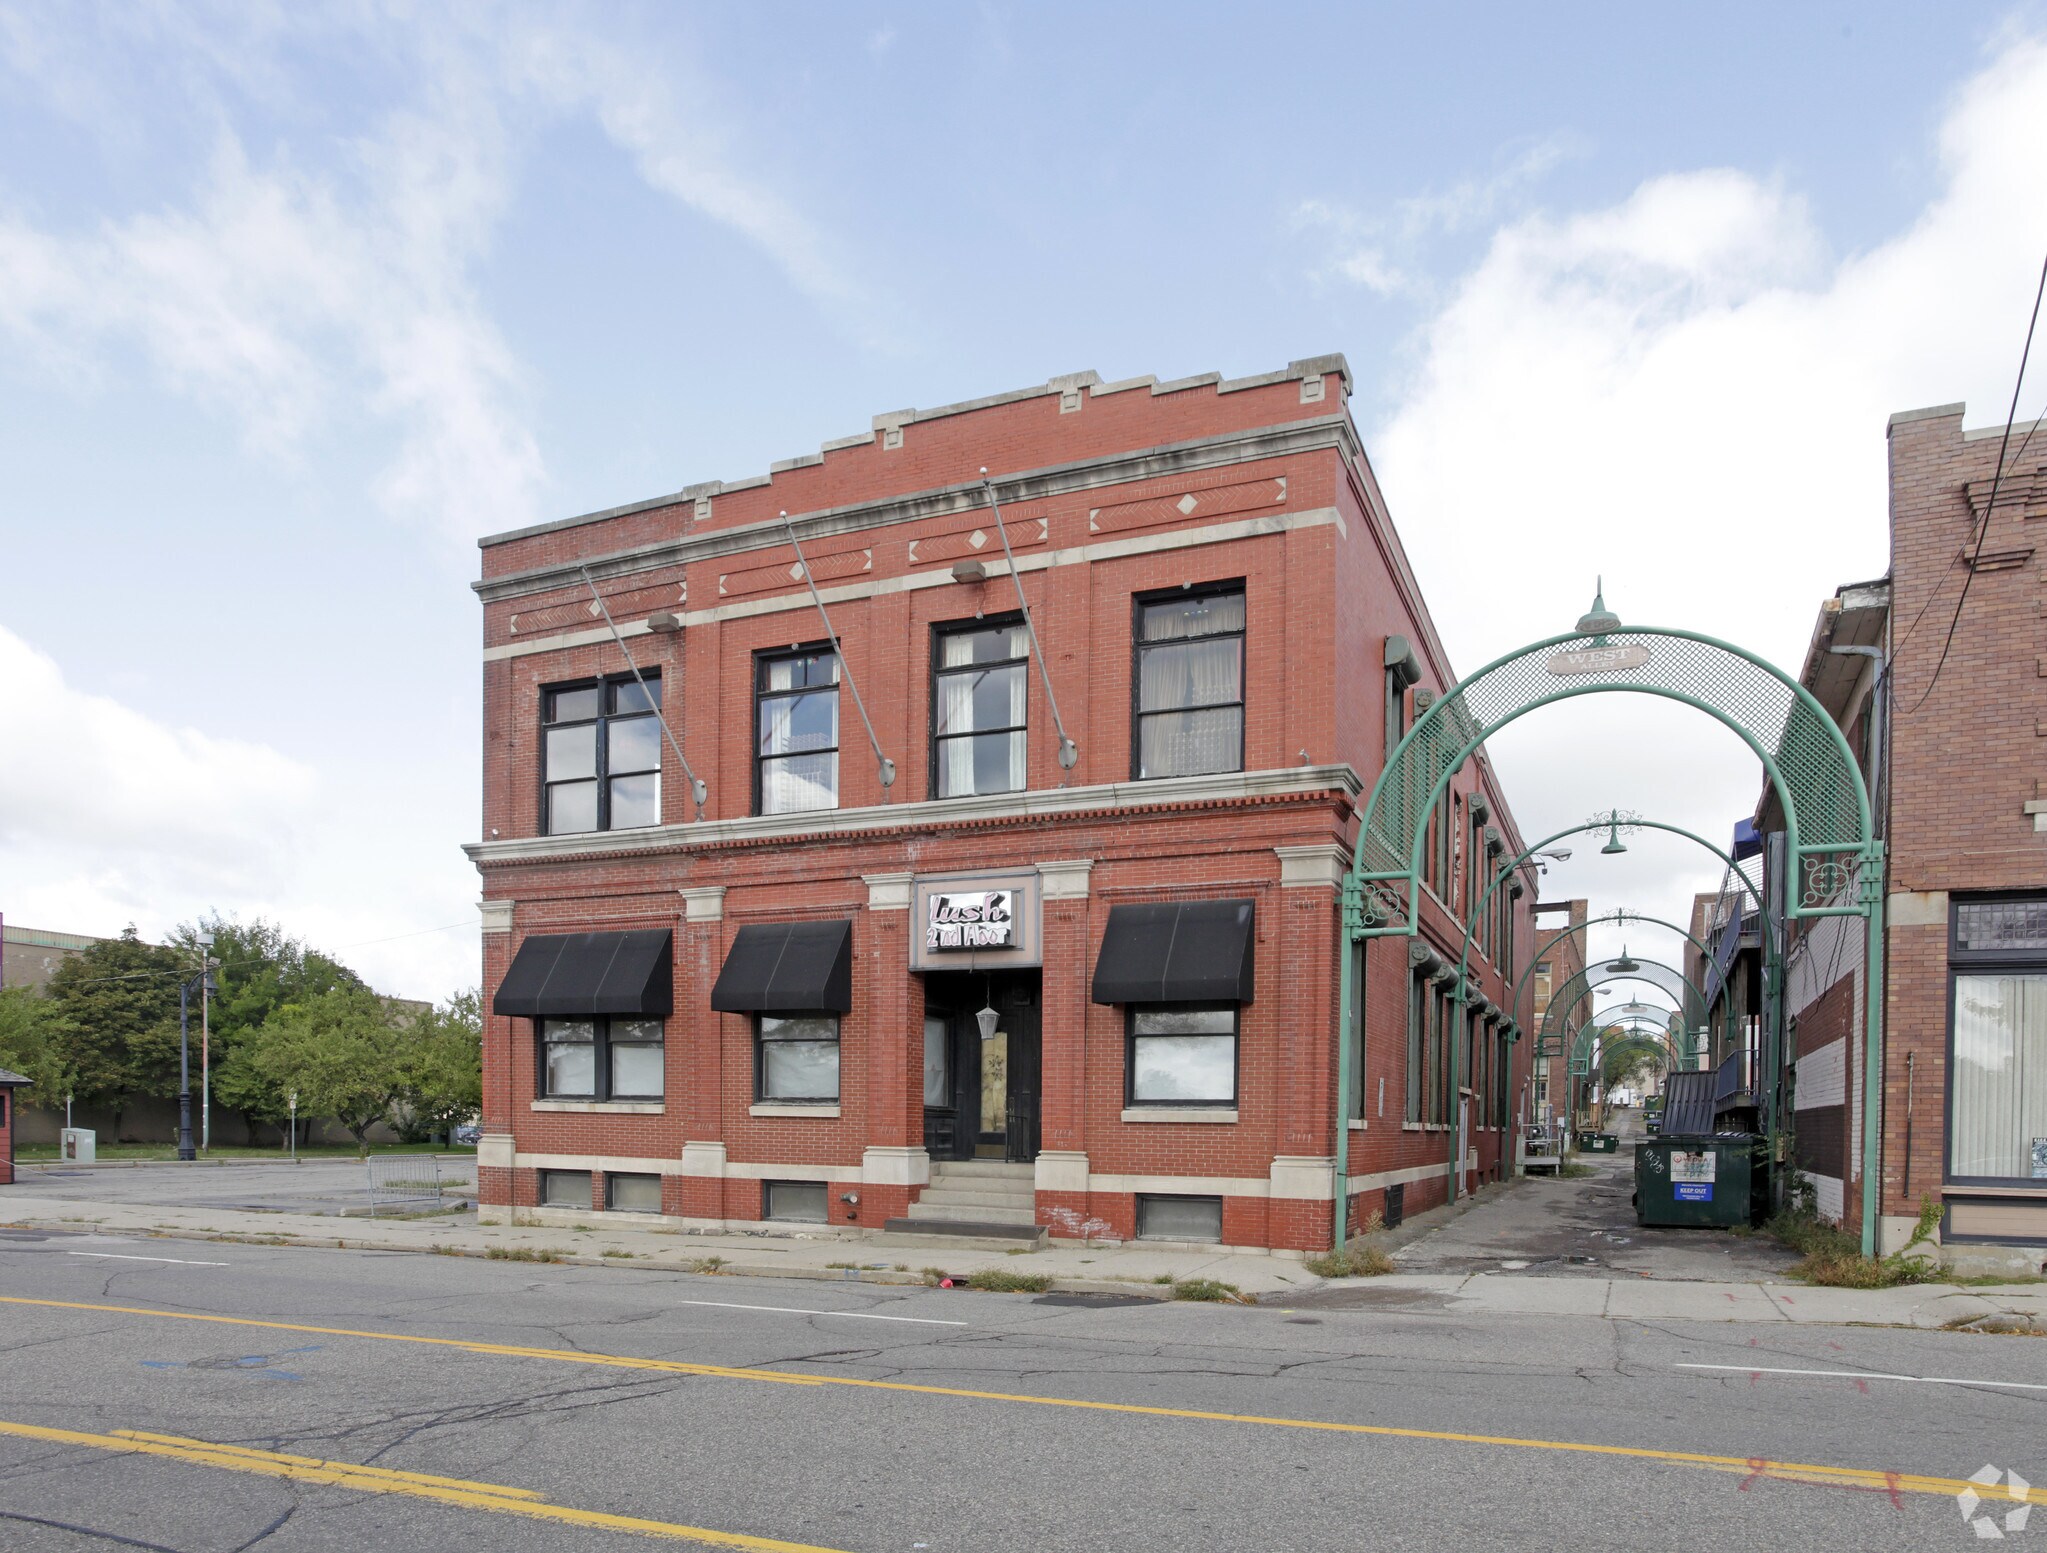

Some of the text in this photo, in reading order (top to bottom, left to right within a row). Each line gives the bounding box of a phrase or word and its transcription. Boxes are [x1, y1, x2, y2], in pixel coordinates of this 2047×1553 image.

[1568, 648, 1631, 664] WEST
[1580, 661, 1615, 670] ALLEY
[927, 925, 962, 947] 2nd
